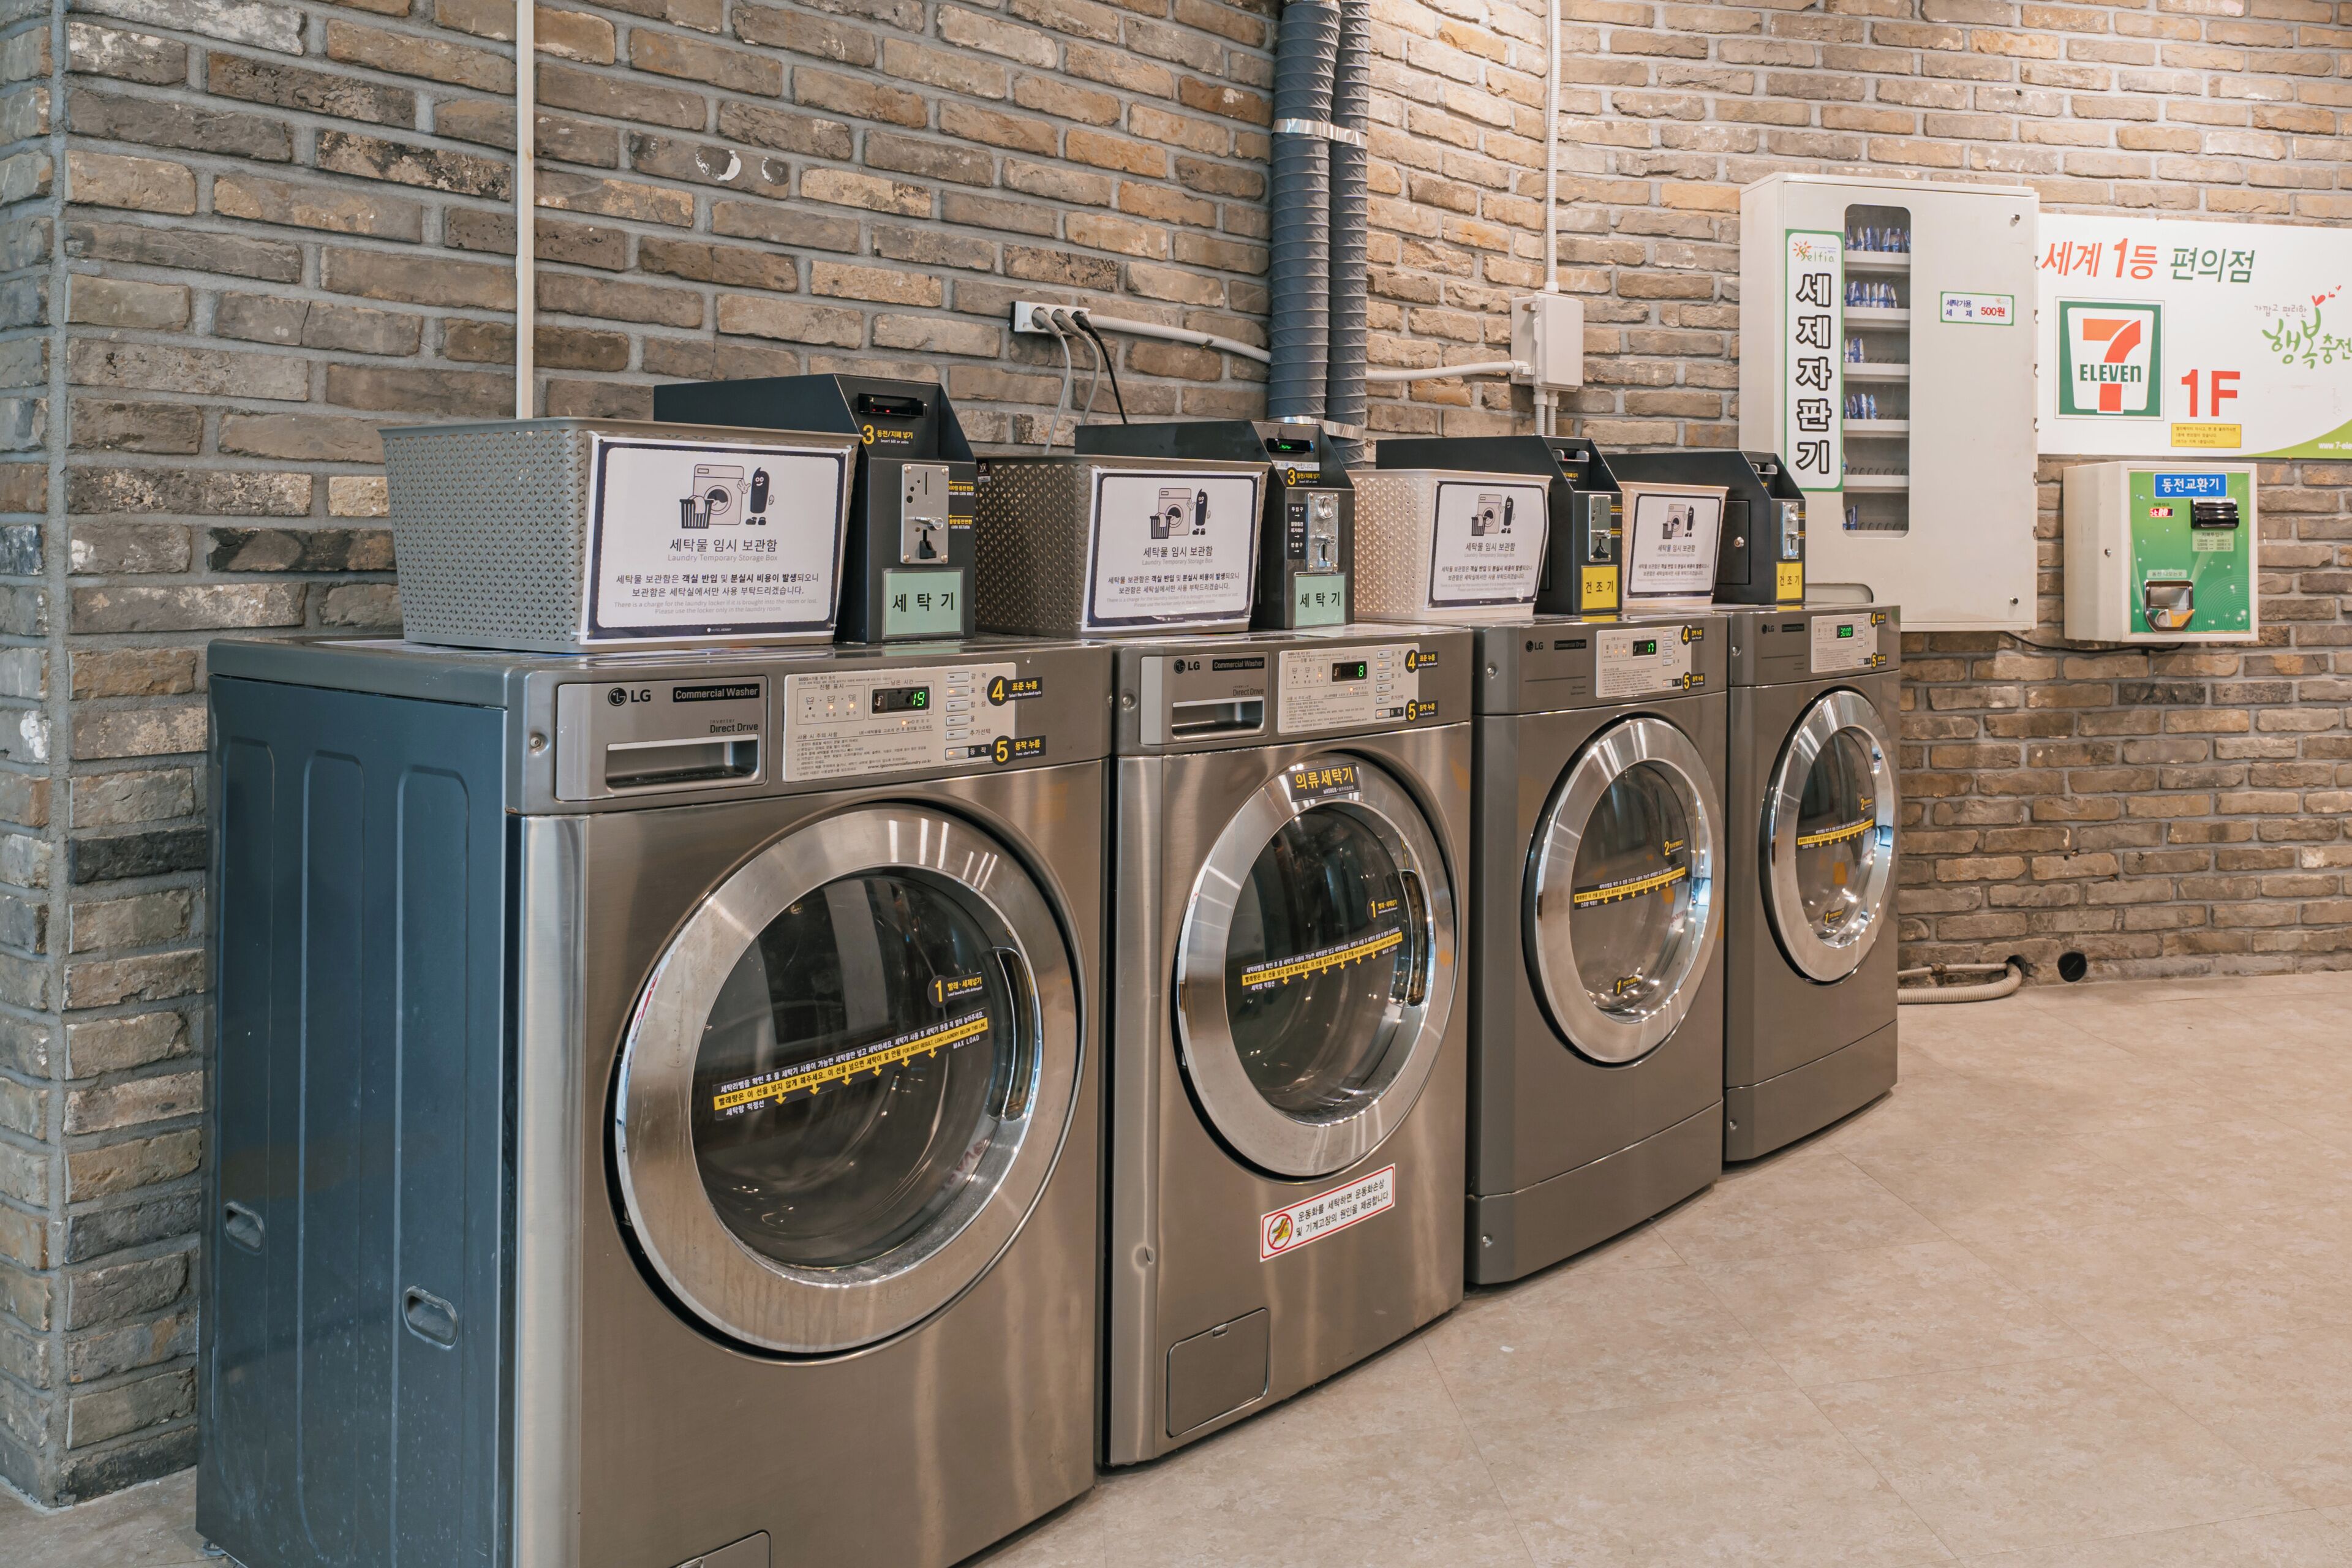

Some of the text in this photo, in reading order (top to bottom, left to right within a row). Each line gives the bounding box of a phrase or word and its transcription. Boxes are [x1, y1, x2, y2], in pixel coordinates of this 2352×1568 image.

[2041, 238, 2255, 284] 세계 1등 편의점
[1946, 299, 1972, 308] 세탁기용
[2254, 304, 2307, 318] 가깝고 편리한
[1980, 307, 2005, 317] 500원
[2180, 369, 2241, 418] 1F
[862, 424, 875, 445] 3
[1287, 469, 1296, 485] 3
[2162, 478, 2220, 493] 동전교환기
[669, 538, 778, 552] 세탁물 임시 보관함
[1143, 545, 1213, 558] 세탁물 임시 보관함
[667, 554, 698, 562] Laundry
[699, 554, 737, 563] Temporary
[739, 554, 764, 563] Storage
[616, 573, 819, 584] 세탁물 보관함은 객실 반입 및 분실시 비용이 발생되오니
[632, 586, 804, 597] 보관함은 세탁실에서만 사용 부탁드리겠습니다.
[1871, 613, 1877, 625] 4
[1683, 628, 1689, 643] 4
[1534, 641, 1544, 650] LG
[1188, 661, 1200, 671] LG
[1213, 660, 1243, 669] Commercial
[1408, 652, 1416, 669] 4
[1872, 654, 1877, 668] 5
[1358, 665, 1365, 677] 8
[992, 679, 1005, 701] 4
[1012, 680, 1038, 691] 표준 누름
[1683, 675, 1690, 690] 5
[630, 687, 759, 703] LG Commercial Washer
[913, 692, 925, 706] 19
[1232, 688, 1250, 696] Direct
[1408, 703, 1416, 720] 5
[709, 722, 759, 733] Direct Drive
[996, 741, 1008, 763] 5
[1015, 739, 1041, 751] 동작 누름
[1664, 840, 1670, 856] 2
[1371, 900, 1376, 918] 1
[935, 980, 943, 1002] 1
[952, 1035, 980, 1049] MAX LOAD
[720, 1081, 750, 1094] 세탁라벨을
[752, 1076, 764, 1085] 확인
[782, 1067, 799, 1078] 세탁기
[800, 1062, 816, 1072] 사용이
[818, 1057, 834, 1068] 가능한
[835, 1050, 856, 1063] 세탁물만
[857, 1049, 867, 1058] 넣고
[895, 1036, 909, 1046] 세탁기
[910, 1032, 919, 1041] 사용
[926, 1026, 939, 1036] 세탁기
[718, 1093, 745, 1106] 빨래량은
[756, 1086, 768, 1097] 선을
[771, 1082, 783, 1092] 넘지
[785, 1079, 797, 1089] 않게
[835, 1065, 846, 1074] 선을
[848, 1057, 864, 1071] 넘으면
[867, 1055, 882, 1065] 세탁이
[884, 1052, 889, 1061] 잘
[891, 1049, 901, 1058] 안됨
[944, 1031, 959, 1041] LAUNDRY
[726, 1100, 765, 1117] 세탁량 적정선
[1298, 1178, 1385, 1223] 운동화를 세탁하면 운동화손상
[1295, 1190, 1389, 1238] 및 기계고장의 원인을 제공합니다
